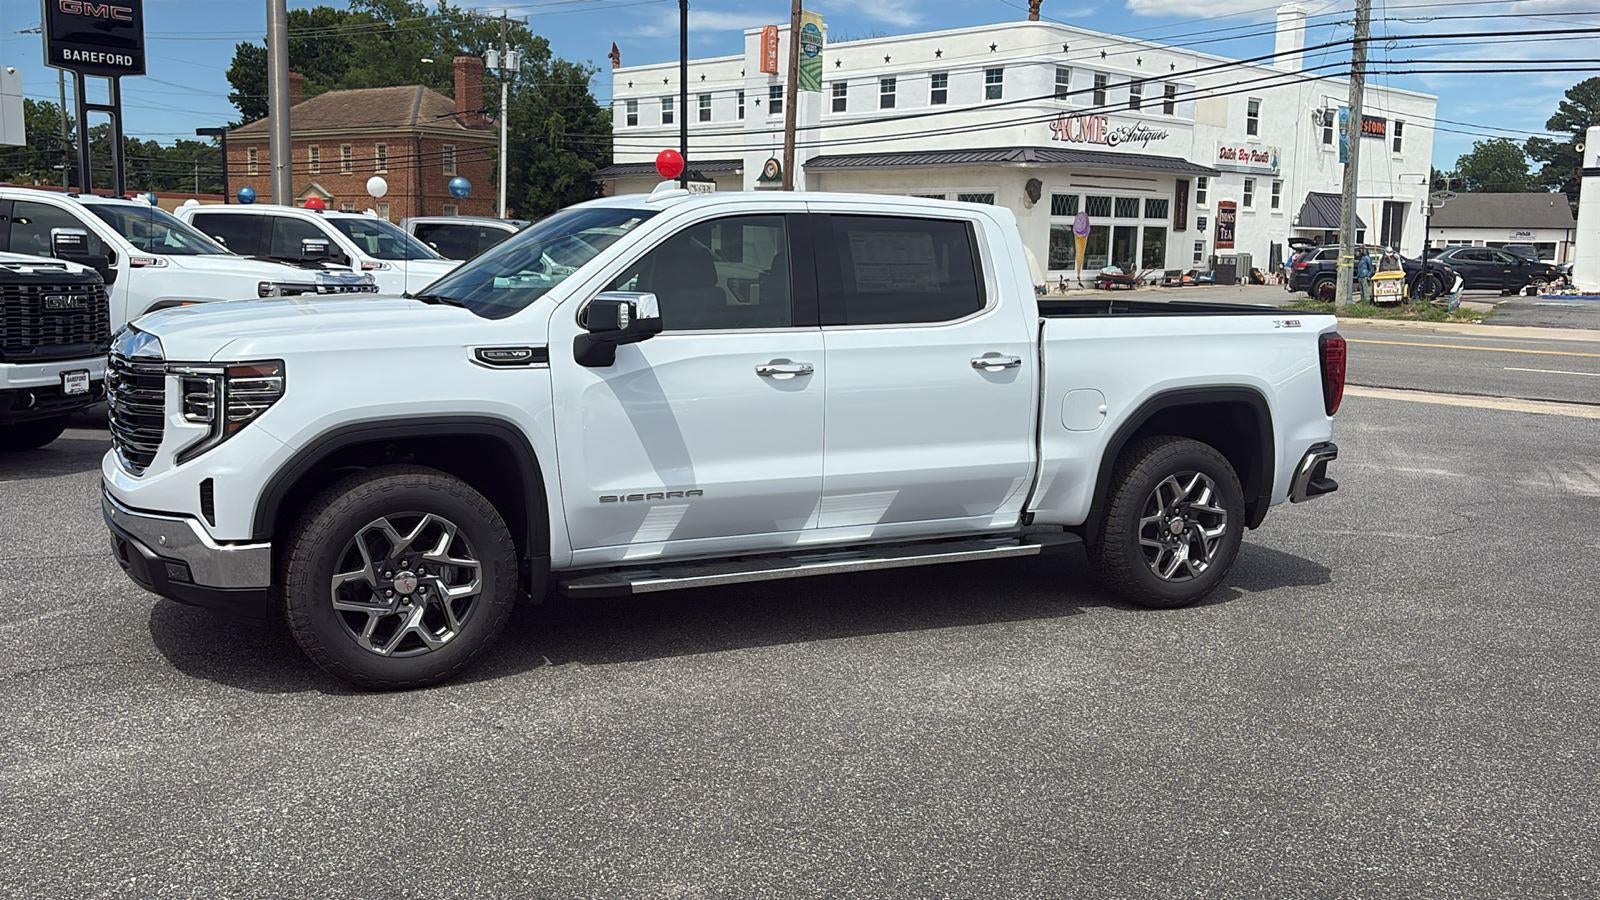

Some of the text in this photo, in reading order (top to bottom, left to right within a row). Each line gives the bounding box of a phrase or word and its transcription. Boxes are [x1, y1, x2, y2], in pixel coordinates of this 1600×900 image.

[59, 0, 133, 21] GMC
[63, 48, 133, 66] BAREFORD
[1049, 111, 1108, 145] ACME
[1219, 147, 1269, 164] Dutch Boy Paints
[1220, 228, 1232, 240] TEA
[45, 295, 88, 309] GMC
[598, 489, 704, 503] SIERRA
